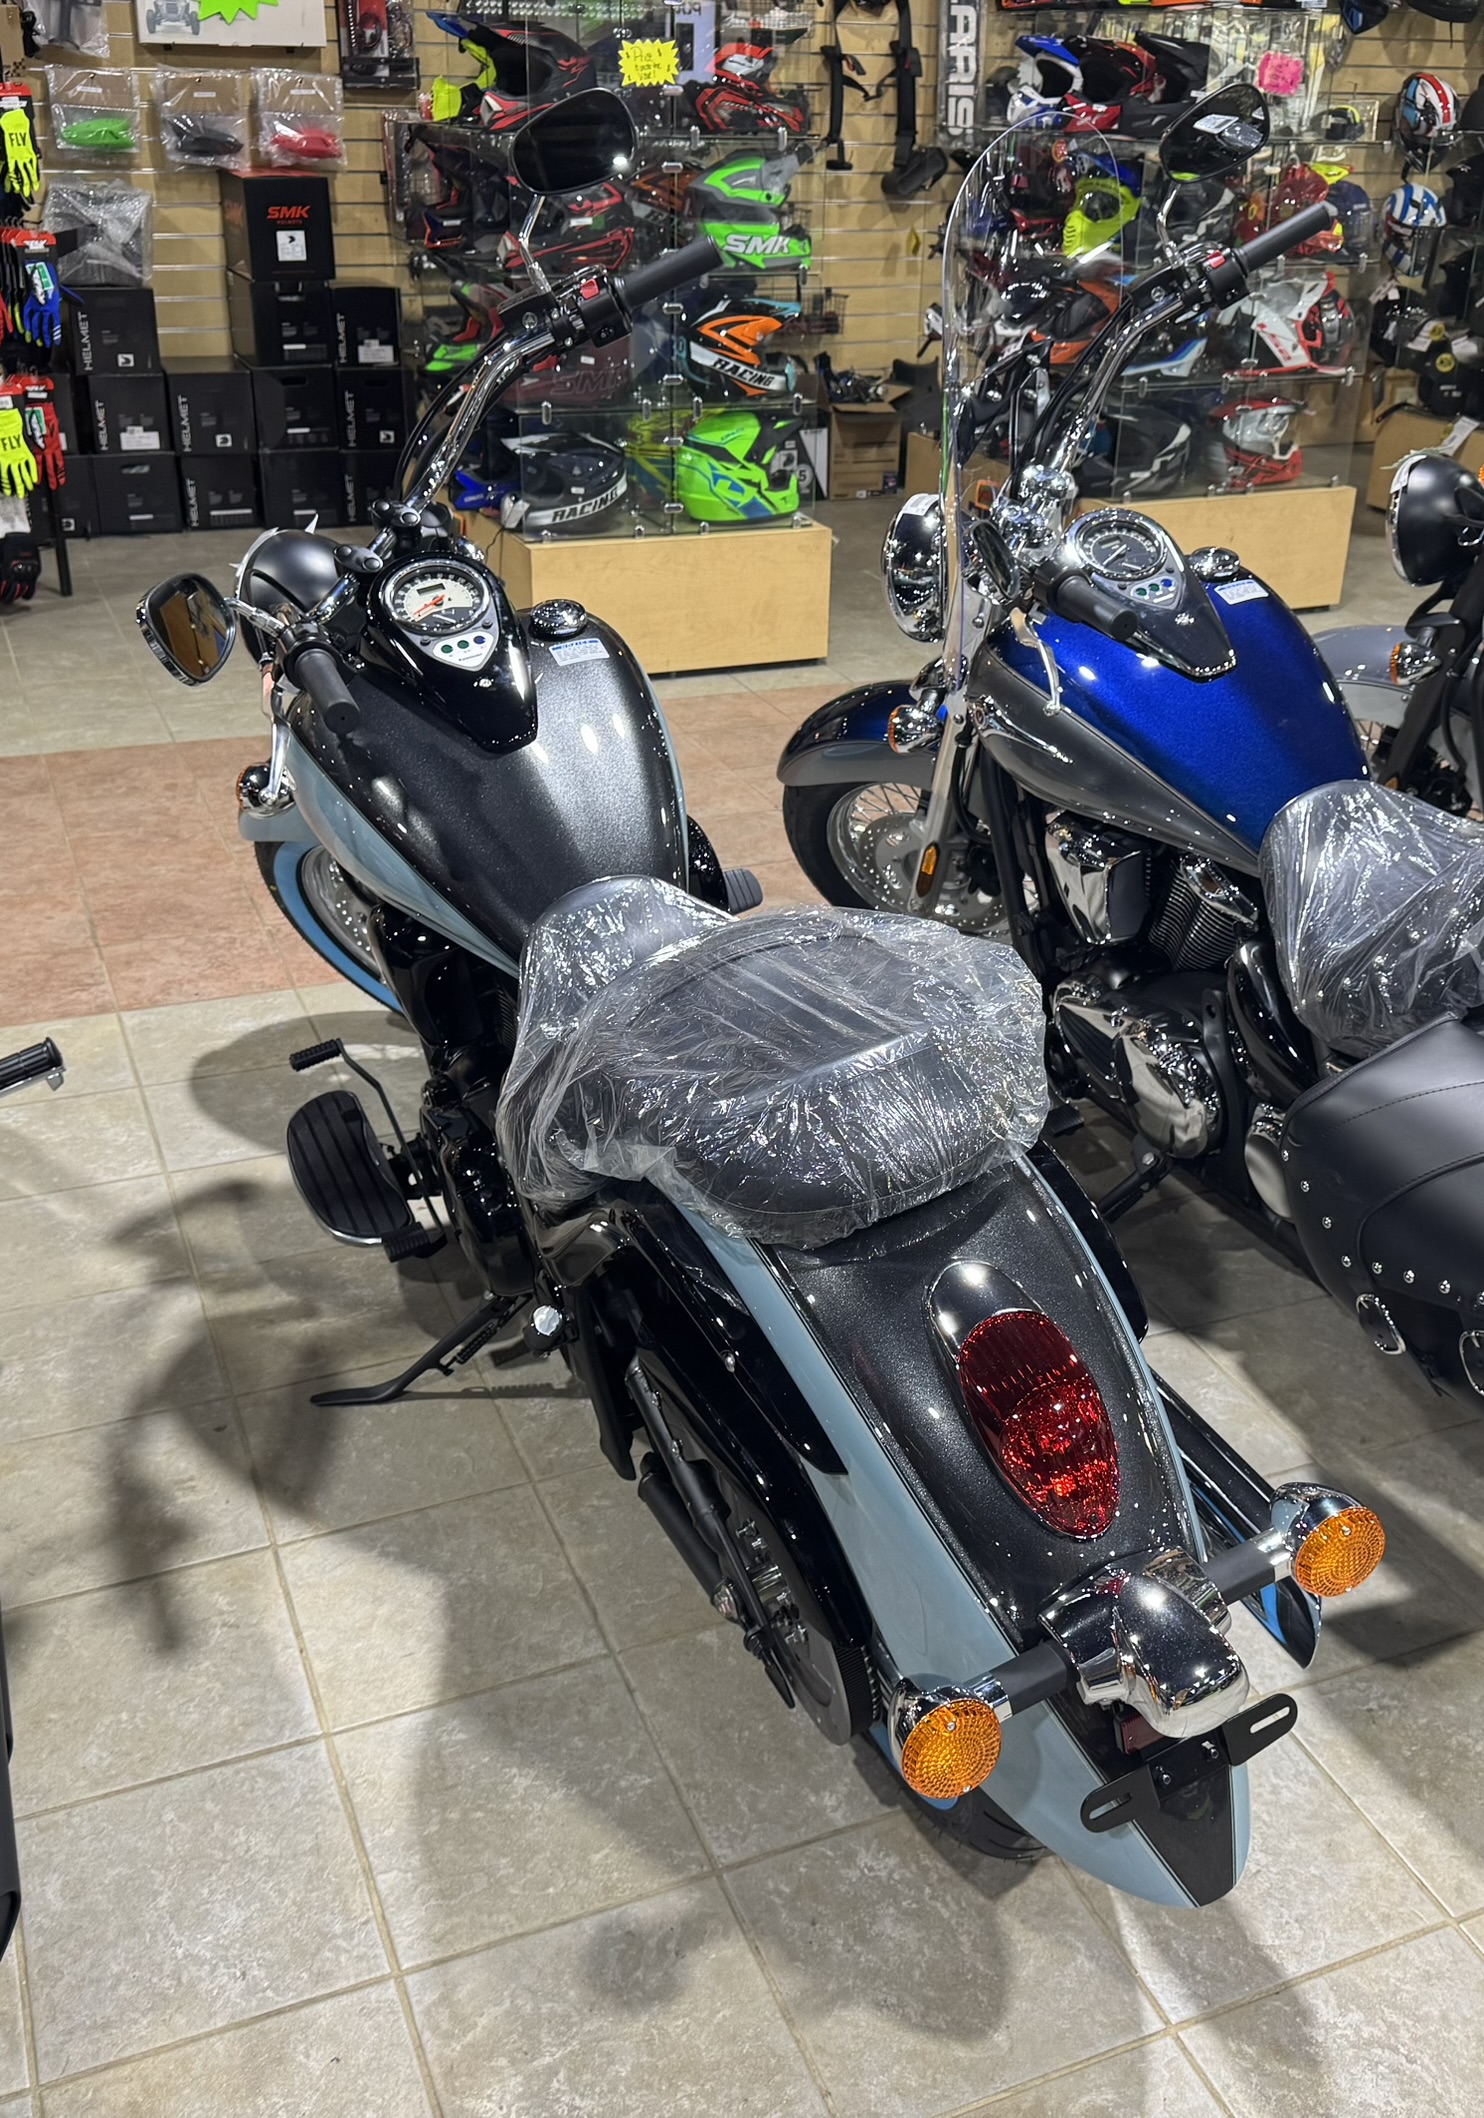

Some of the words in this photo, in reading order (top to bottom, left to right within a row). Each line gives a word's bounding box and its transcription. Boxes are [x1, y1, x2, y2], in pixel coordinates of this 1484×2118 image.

[947, 0, 977, 136] ARIS
[8, 132, 27, 147] FLY
[266, 205, 310, 220] SMK
[723, 234, 790, 255] SMK
[77, 311, 94, 371] HELMET
[336, 312, 348, 363] HELMET
[712, 357, 775, 387] RACING
[95, 400, 108, 451] HELMET
[177, 394, 192, 452] HELMET
[344, 389, 357, 447] HELMET
[2, 434, 22, 452] FLY
[344, 474, 357, 522] HELMET
[798, 469, 807, 482] 5
[185, 478, 199, 527] HELMET
[552, 486, 618, 523] RACING
